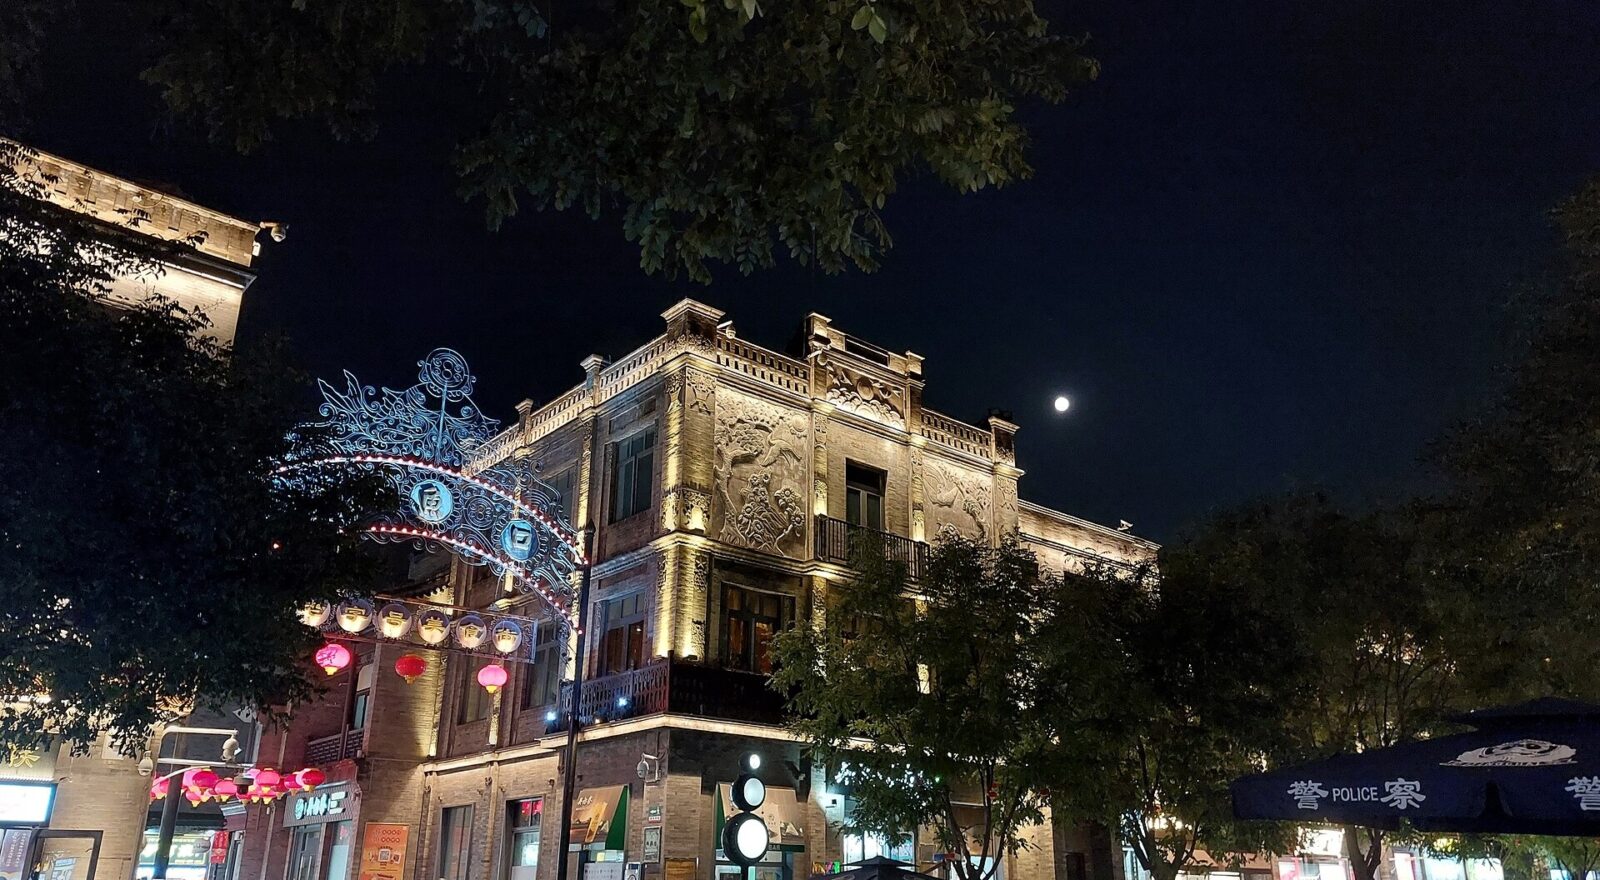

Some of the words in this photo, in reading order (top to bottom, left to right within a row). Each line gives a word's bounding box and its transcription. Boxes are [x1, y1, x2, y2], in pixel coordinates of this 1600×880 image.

[1287, 779, 1329, 810] 警
[1332, 787, 1378, 802] POLICE
[1380, 778, 1426, 809] 察
